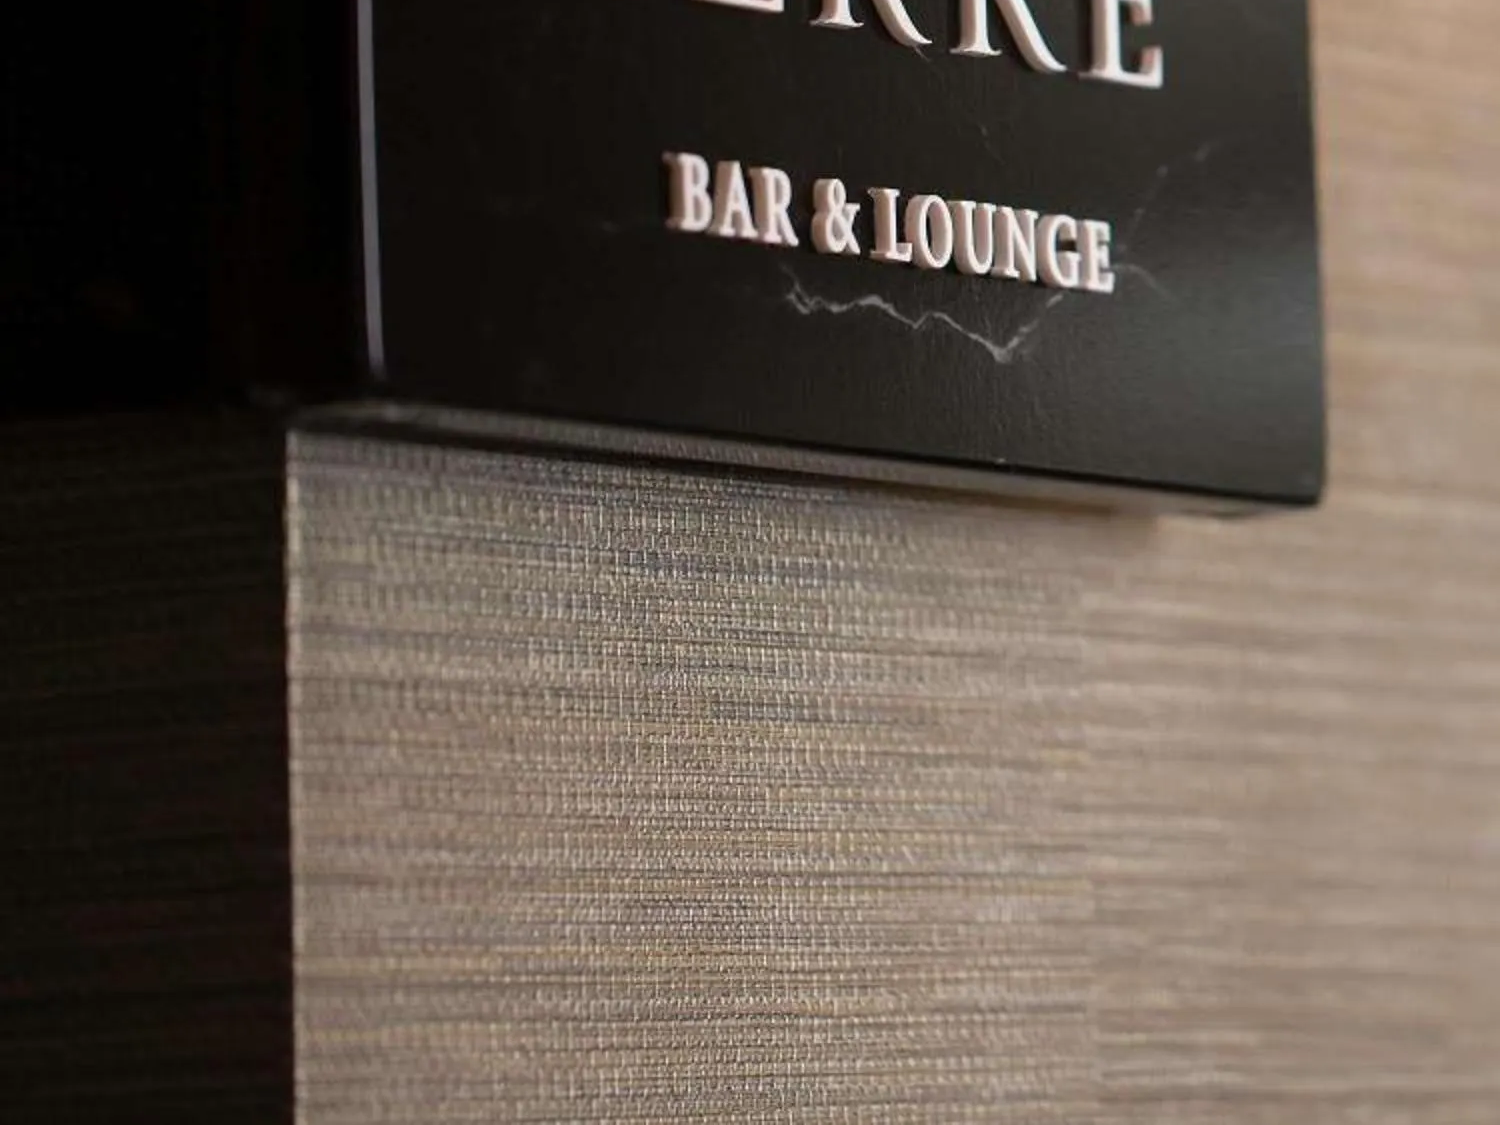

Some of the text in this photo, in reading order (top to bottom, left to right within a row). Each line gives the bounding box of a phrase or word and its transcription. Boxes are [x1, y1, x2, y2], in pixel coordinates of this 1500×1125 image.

[663, 151, 1116, 294] BAR & LOUNGE
